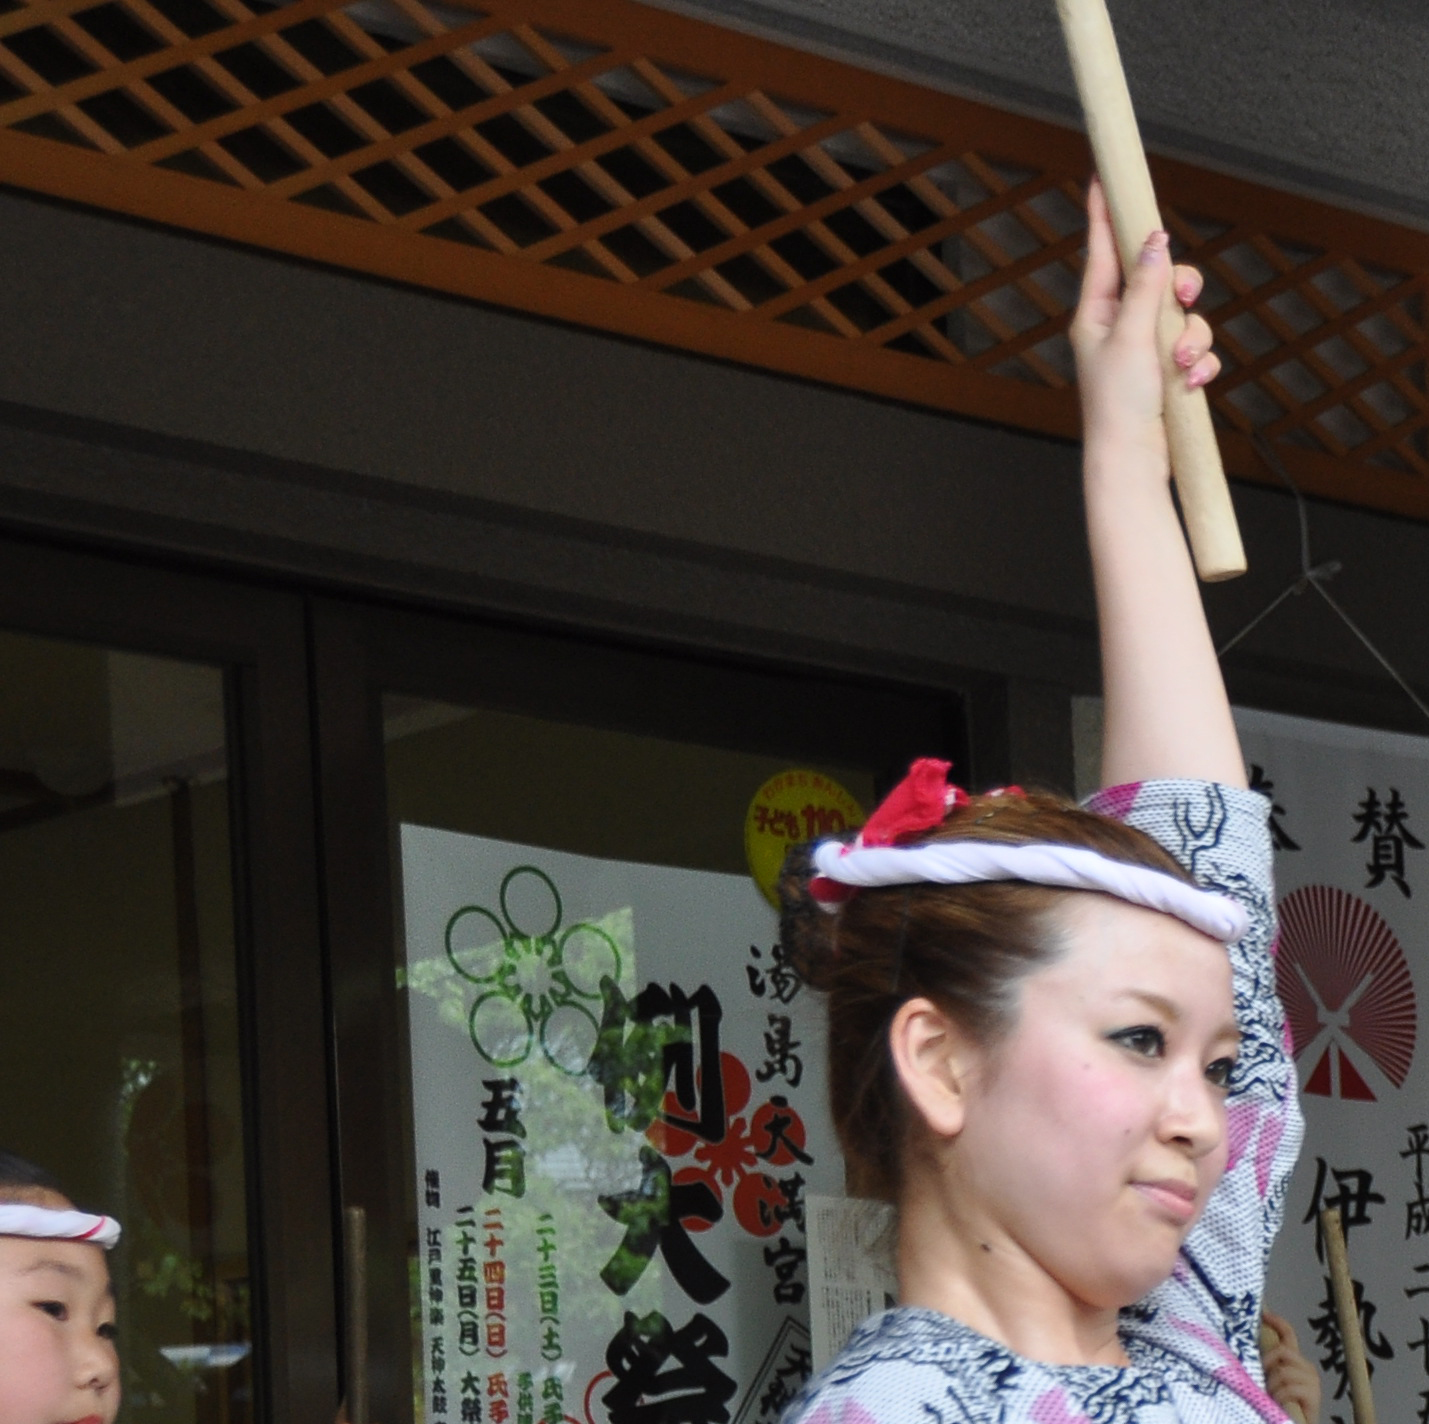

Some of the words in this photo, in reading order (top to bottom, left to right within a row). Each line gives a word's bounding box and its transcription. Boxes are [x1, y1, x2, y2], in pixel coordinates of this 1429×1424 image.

[478, 1077, 527, 1199] 五月
[746, 944, 815, 1305] 湯島天満宮
